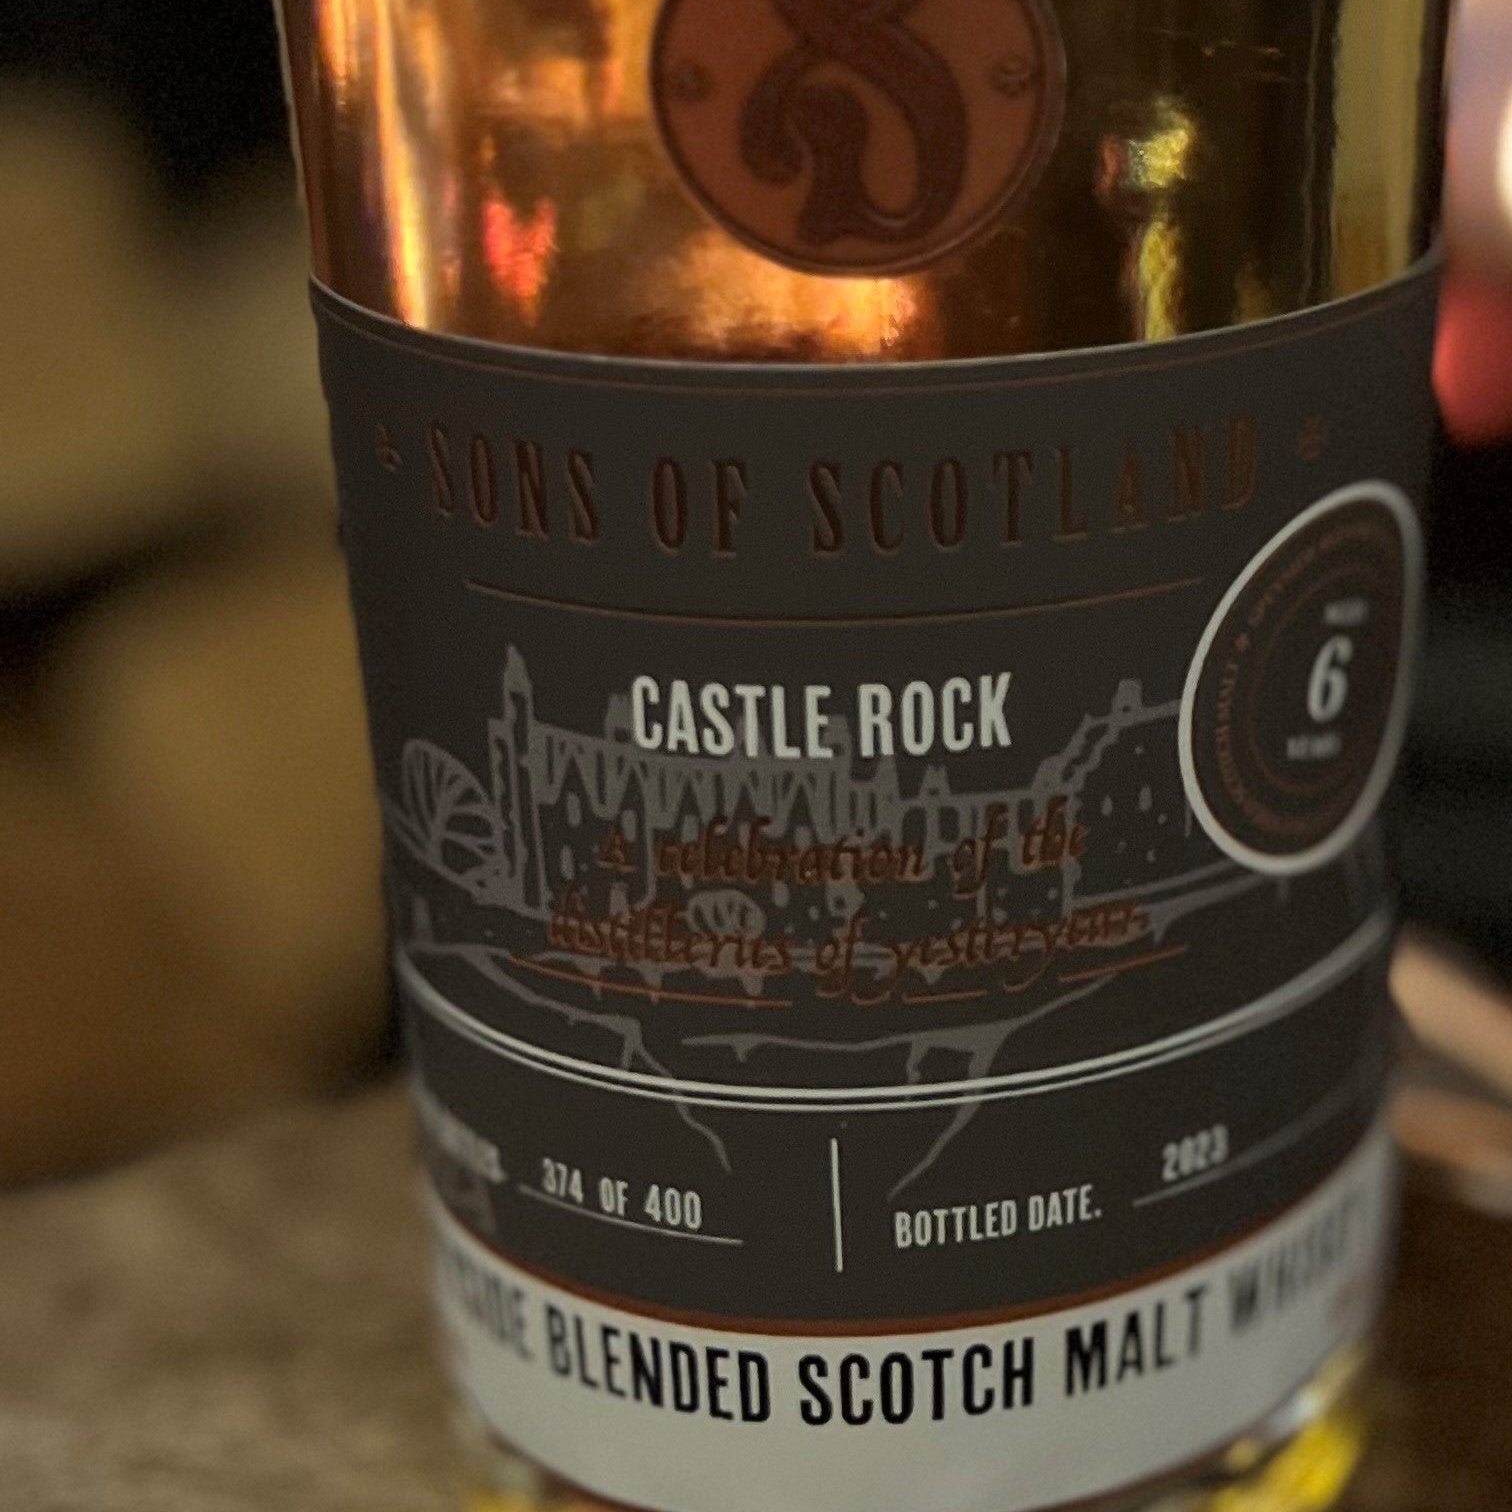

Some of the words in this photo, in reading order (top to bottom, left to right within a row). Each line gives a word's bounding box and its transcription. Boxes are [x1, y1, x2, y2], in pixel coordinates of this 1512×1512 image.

[426, 420, 600, 545] SONS
[651, 455, 749, 557] OF
[808, 411, 1262, 557] SCOTLAND
[631, 675, 833, 758] CASTLE
[858, 671, 1012, 757] ROCK
[1307, 635, 1354, 722] 6
[652, 816, 926, 882] celebration
[952, 800, 1010, 899] of
[600, 1177, 629, 1217] OF
[645, 1184, 702, 1230] 400
[894, 1199, 1017, 1249] BOTTLED
[1028, 1184, 1102, 1232] DATE.
[545, 1303, 771, 1425] BLENDED
[798, 1338, 1035, 1427] SCOTCH
[1064, 1283, 1208, 1399] MALT
